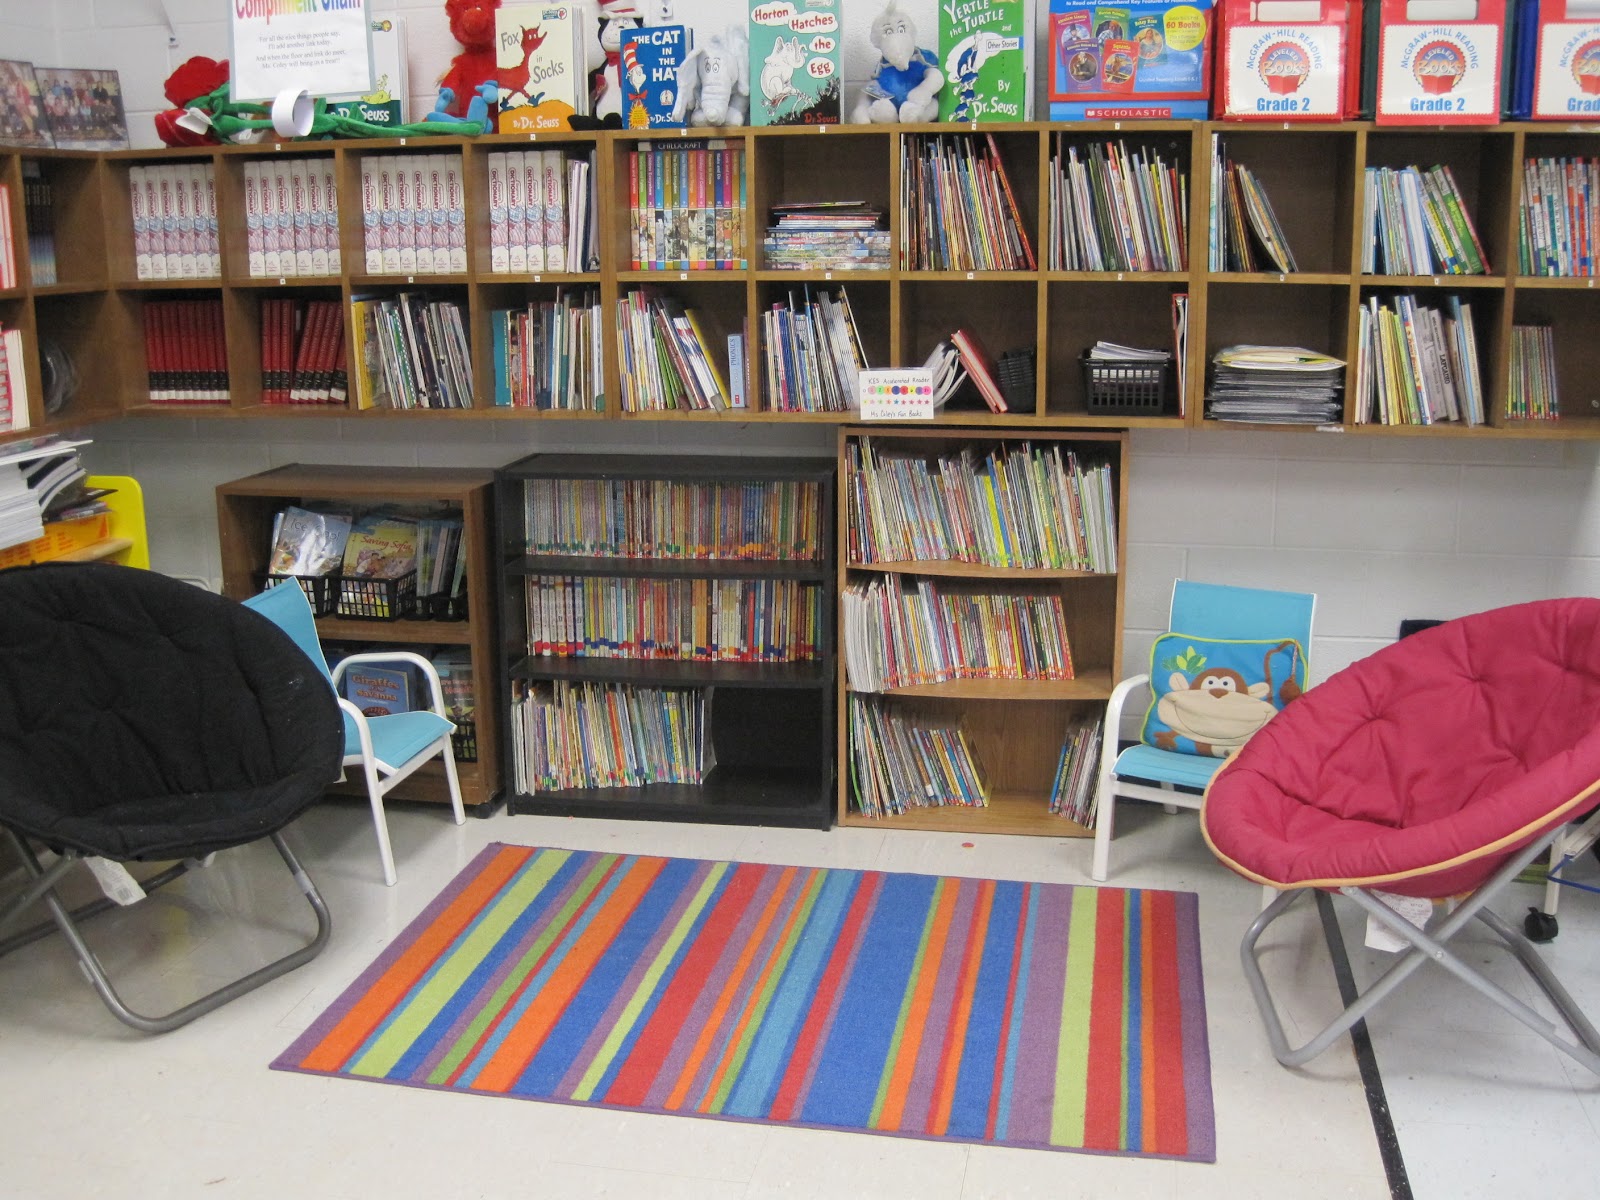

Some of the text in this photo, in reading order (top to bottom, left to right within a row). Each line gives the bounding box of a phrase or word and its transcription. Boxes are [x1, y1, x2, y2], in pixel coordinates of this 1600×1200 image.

[755, 9, 789, 21] Horton
[791, 15, 834, 30] Hatches
[949, 9, 1004, 38] the TURTLE
[1001, 24, 1012, 32] and
[501, 31, 521, 52] Fox
[632, 30, 681, 46] THE CAT
[814, 38, 831, 50] the
[662, 47, 672, 55] IN
[1456, 31, 1479, 69] READING
[536, 54, 543, 63] in
[658, 57, 676, 66] THE
[532, 59, 565, 84] Socks
[652, 67, 678, 82] HAT
[810, 61, 831, 76] Egg
[998, 79, 1011, 93] By
[971, 96, 1018, 118] Dr. Seuss
[1256, 97, 1310, 112] Grade 2
[1410, 97, 1465, 112] Grade 2
[1567, 97, 1600, 112] Grad
[359, 104, 390, 122] Seuss
[816, 112, 838, 123] Seuss
[1098, 109, 1169, 117] SCHOLASTIC
[521, 116, 535, 130] Dr.
[536, 115, 560, 130] Seuss
[729, 337, 737, 366] PHONICS
[1439, 354, 1451, 385] LAFCADIO
[290, 518, 308, 532] Ice
[361, 535, 389, 549] Saving
[352, 674, 400, 690] Giraffes
[356, 689, 398, 702] Savanna
